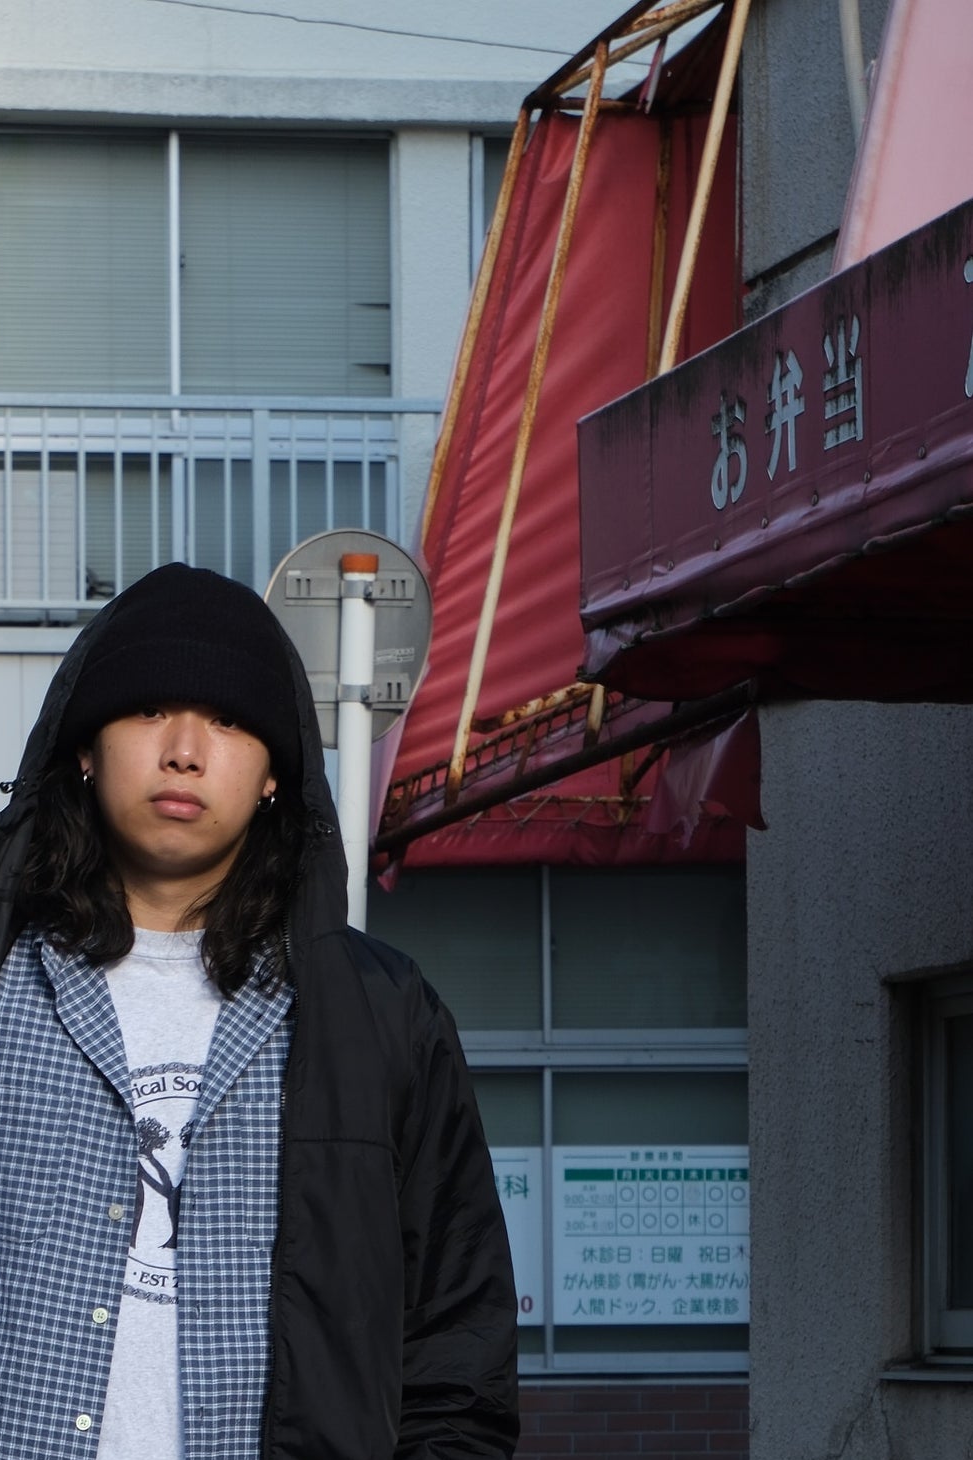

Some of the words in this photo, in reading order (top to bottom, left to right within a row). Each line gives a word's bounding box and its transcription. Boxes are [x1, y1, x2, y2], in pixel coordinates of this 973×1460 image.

[711, 314, 863, 511] お弁当
[495, 1174, 529, 1199] 科
[139, 1271, 168, 1287] EST
